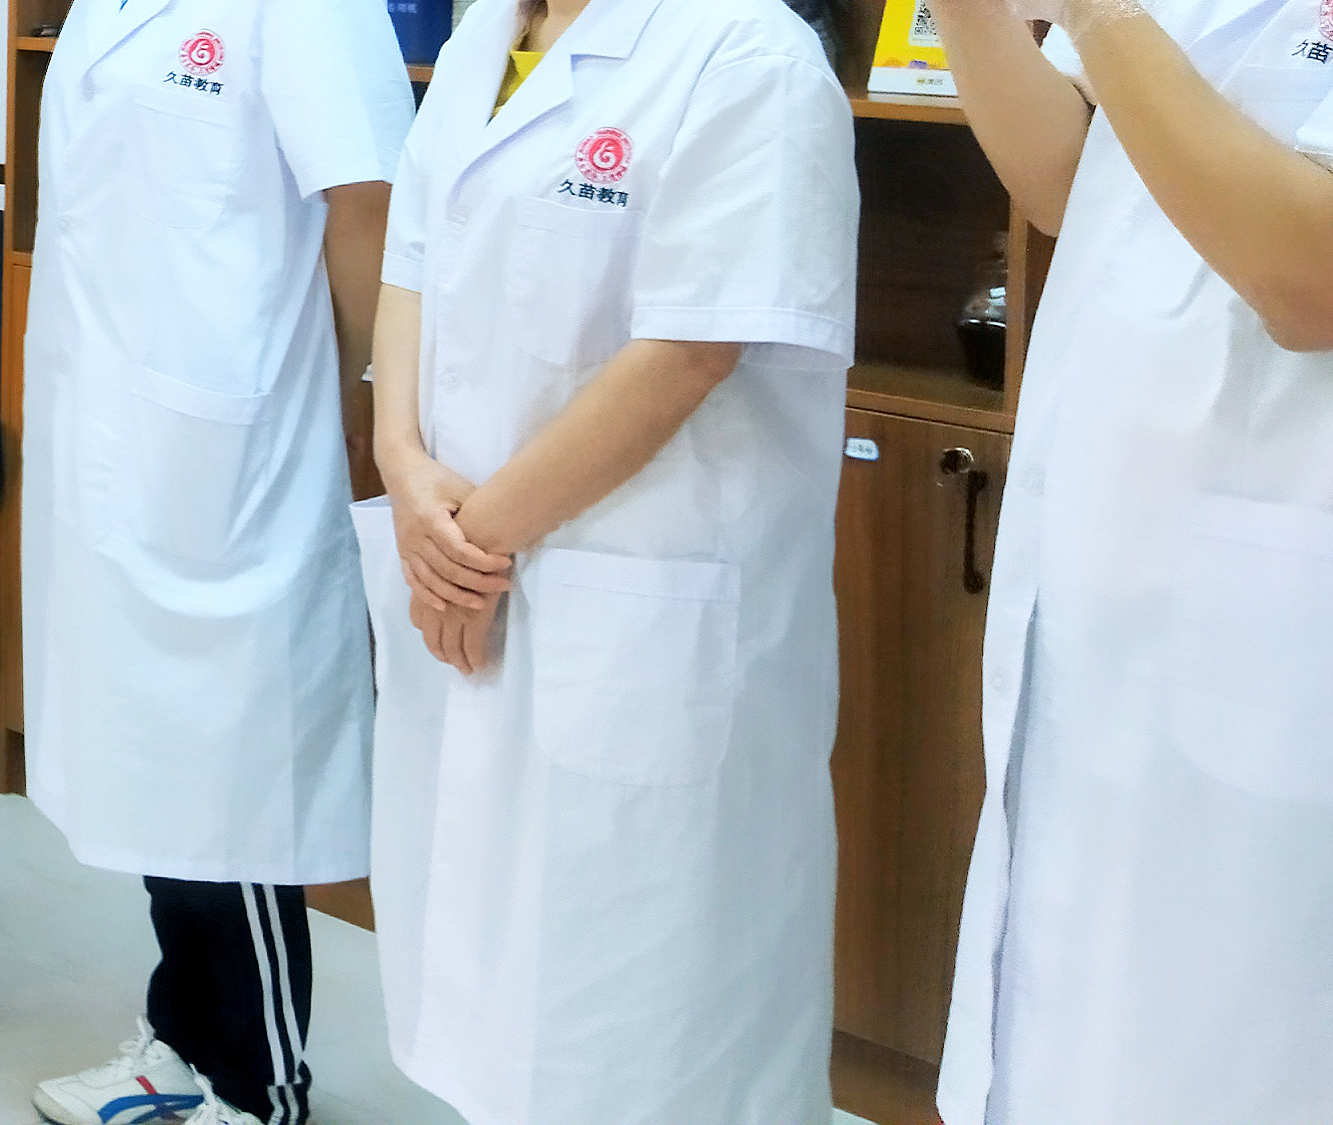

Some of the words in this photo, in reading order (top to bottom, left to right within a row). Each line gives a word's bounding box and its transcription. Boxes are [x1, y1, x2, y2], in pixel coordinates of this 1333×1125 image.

[162, 70, 225, 96] 久苗教育
[556, 178, 630, 208] 久苗教育
